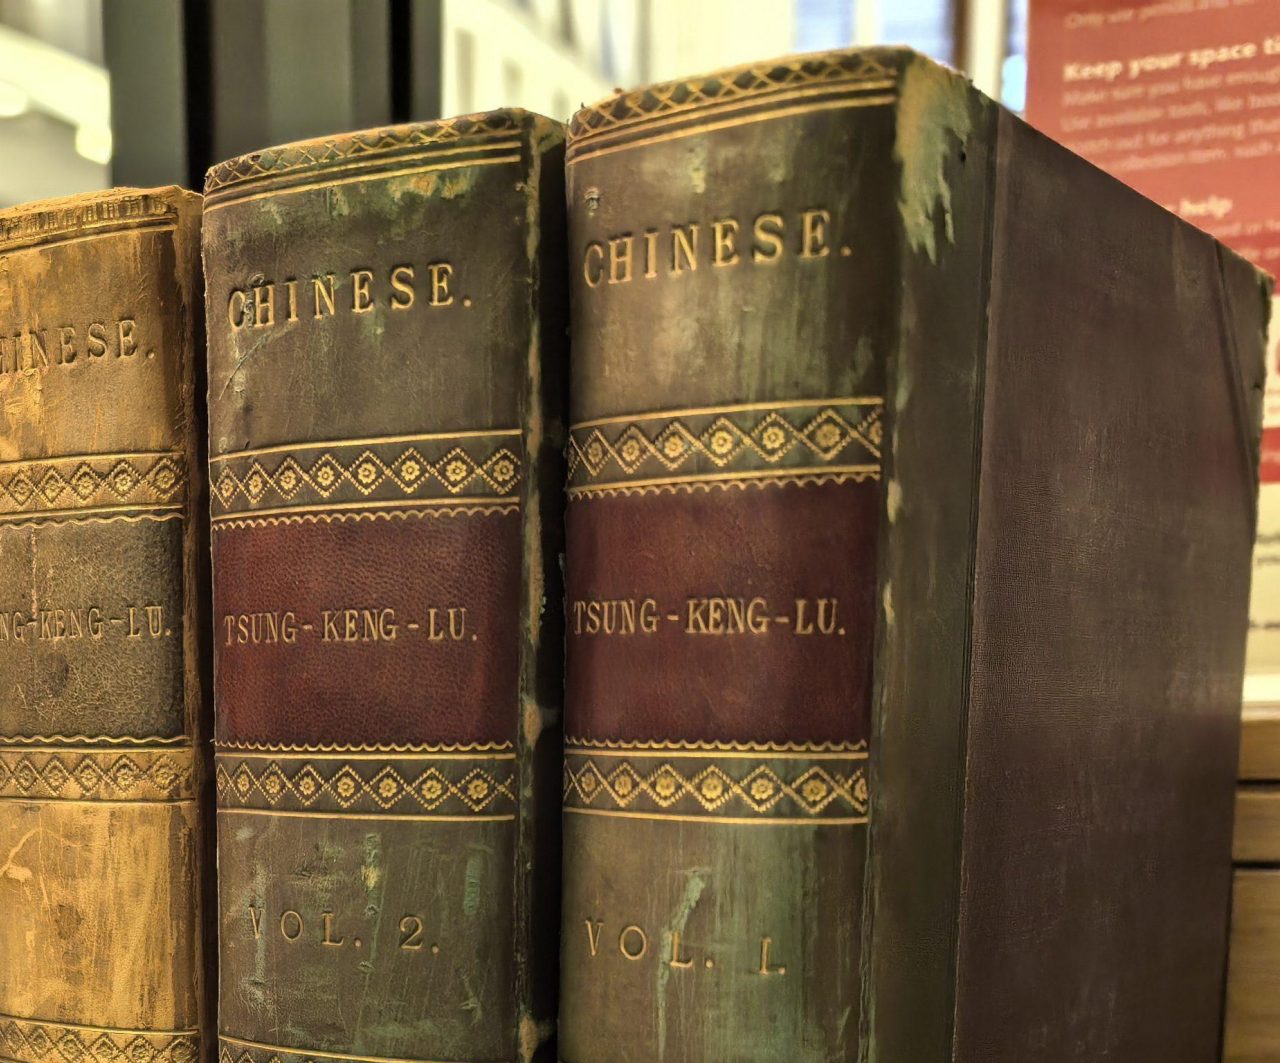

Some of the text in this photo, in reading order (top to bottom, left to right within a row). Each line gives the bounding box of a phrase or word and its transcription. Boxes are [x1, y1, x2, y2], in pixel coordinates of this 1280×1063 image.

[1062, 61, 1123, 82] Keep
[1128, 52, 1184, 79] your
[1188, 42, 1257, 70] space
[583, 209, 853, 289] CHINESE.
[227, 261, 473, 334] CHINESE.
[248, 903, 440, 956] VOL. 2.
[585, 919, 714, 969] VOL.
